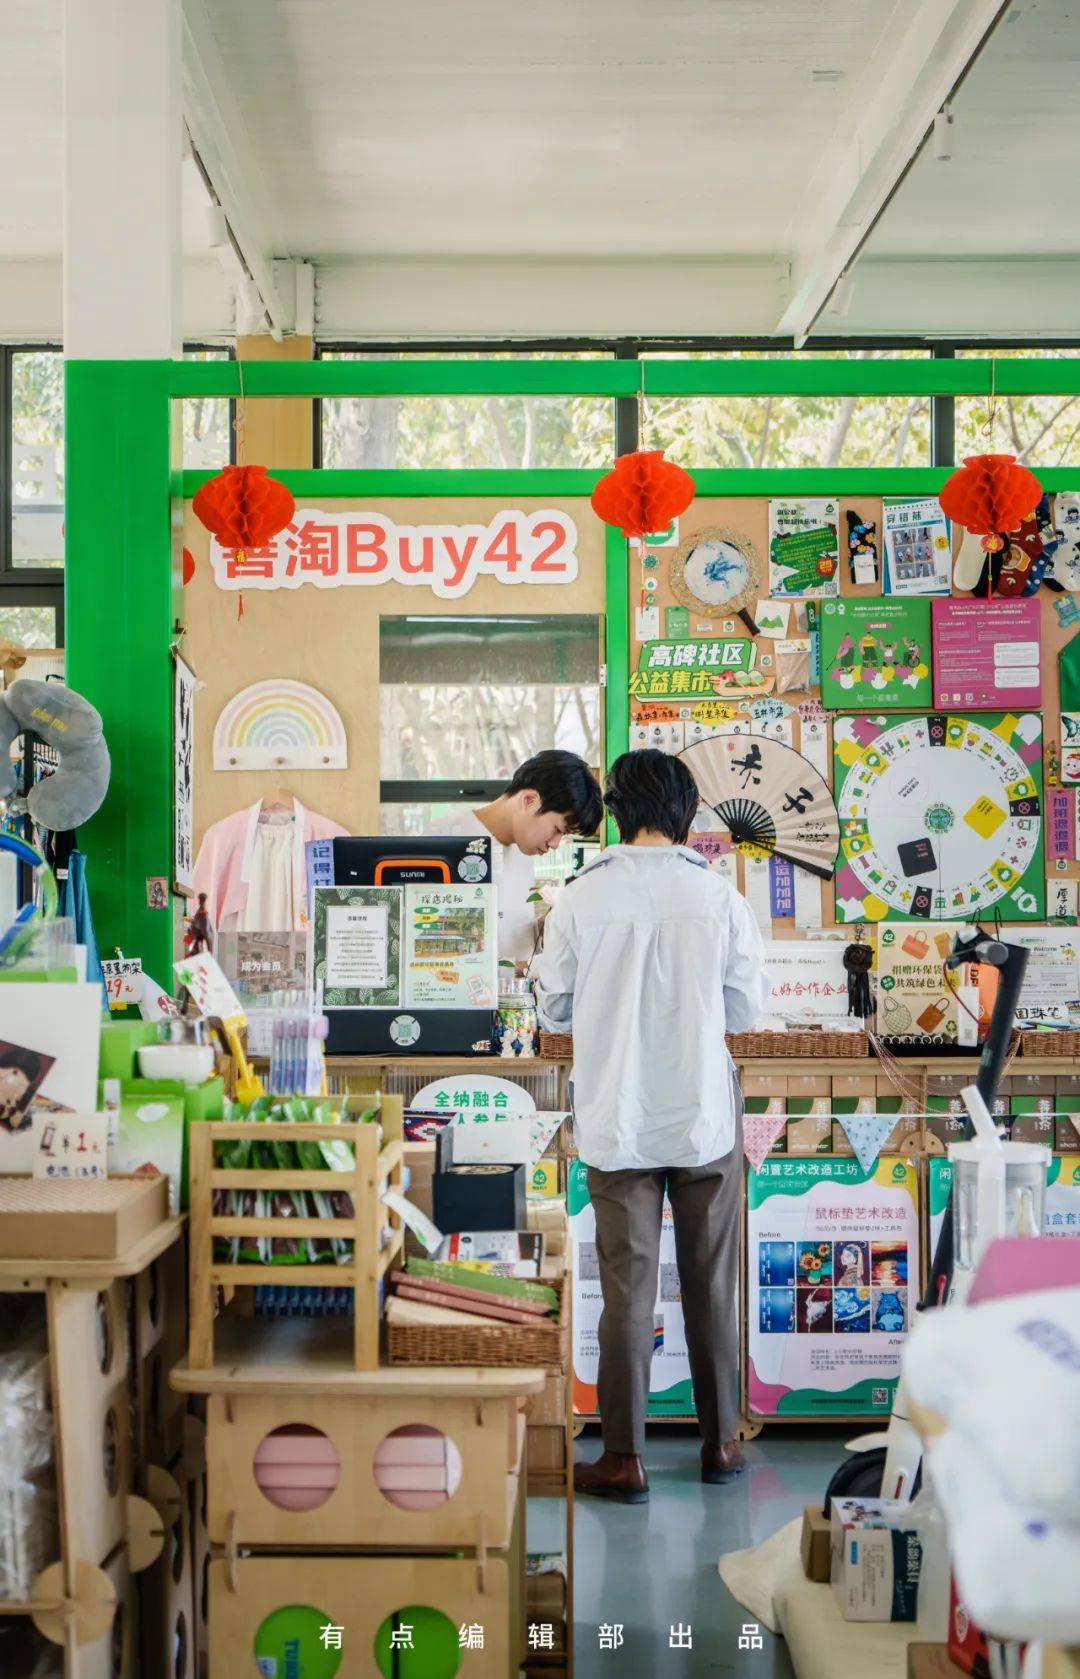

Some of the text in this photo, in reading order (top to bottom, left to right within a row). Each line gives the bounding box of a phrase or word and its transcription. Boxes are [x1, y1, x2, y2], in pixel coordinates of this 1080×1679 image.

[649, 643, 746, 667] 高碑社区
[629, 669, 713, 694] 公益集市
[434, 1090, 508, 1107] 全纳融合
[756, 1163, 858, 1176] 闲置艺术改造工坊
[815, 1207, 907, 1220] 鼠标垫艺术改造
